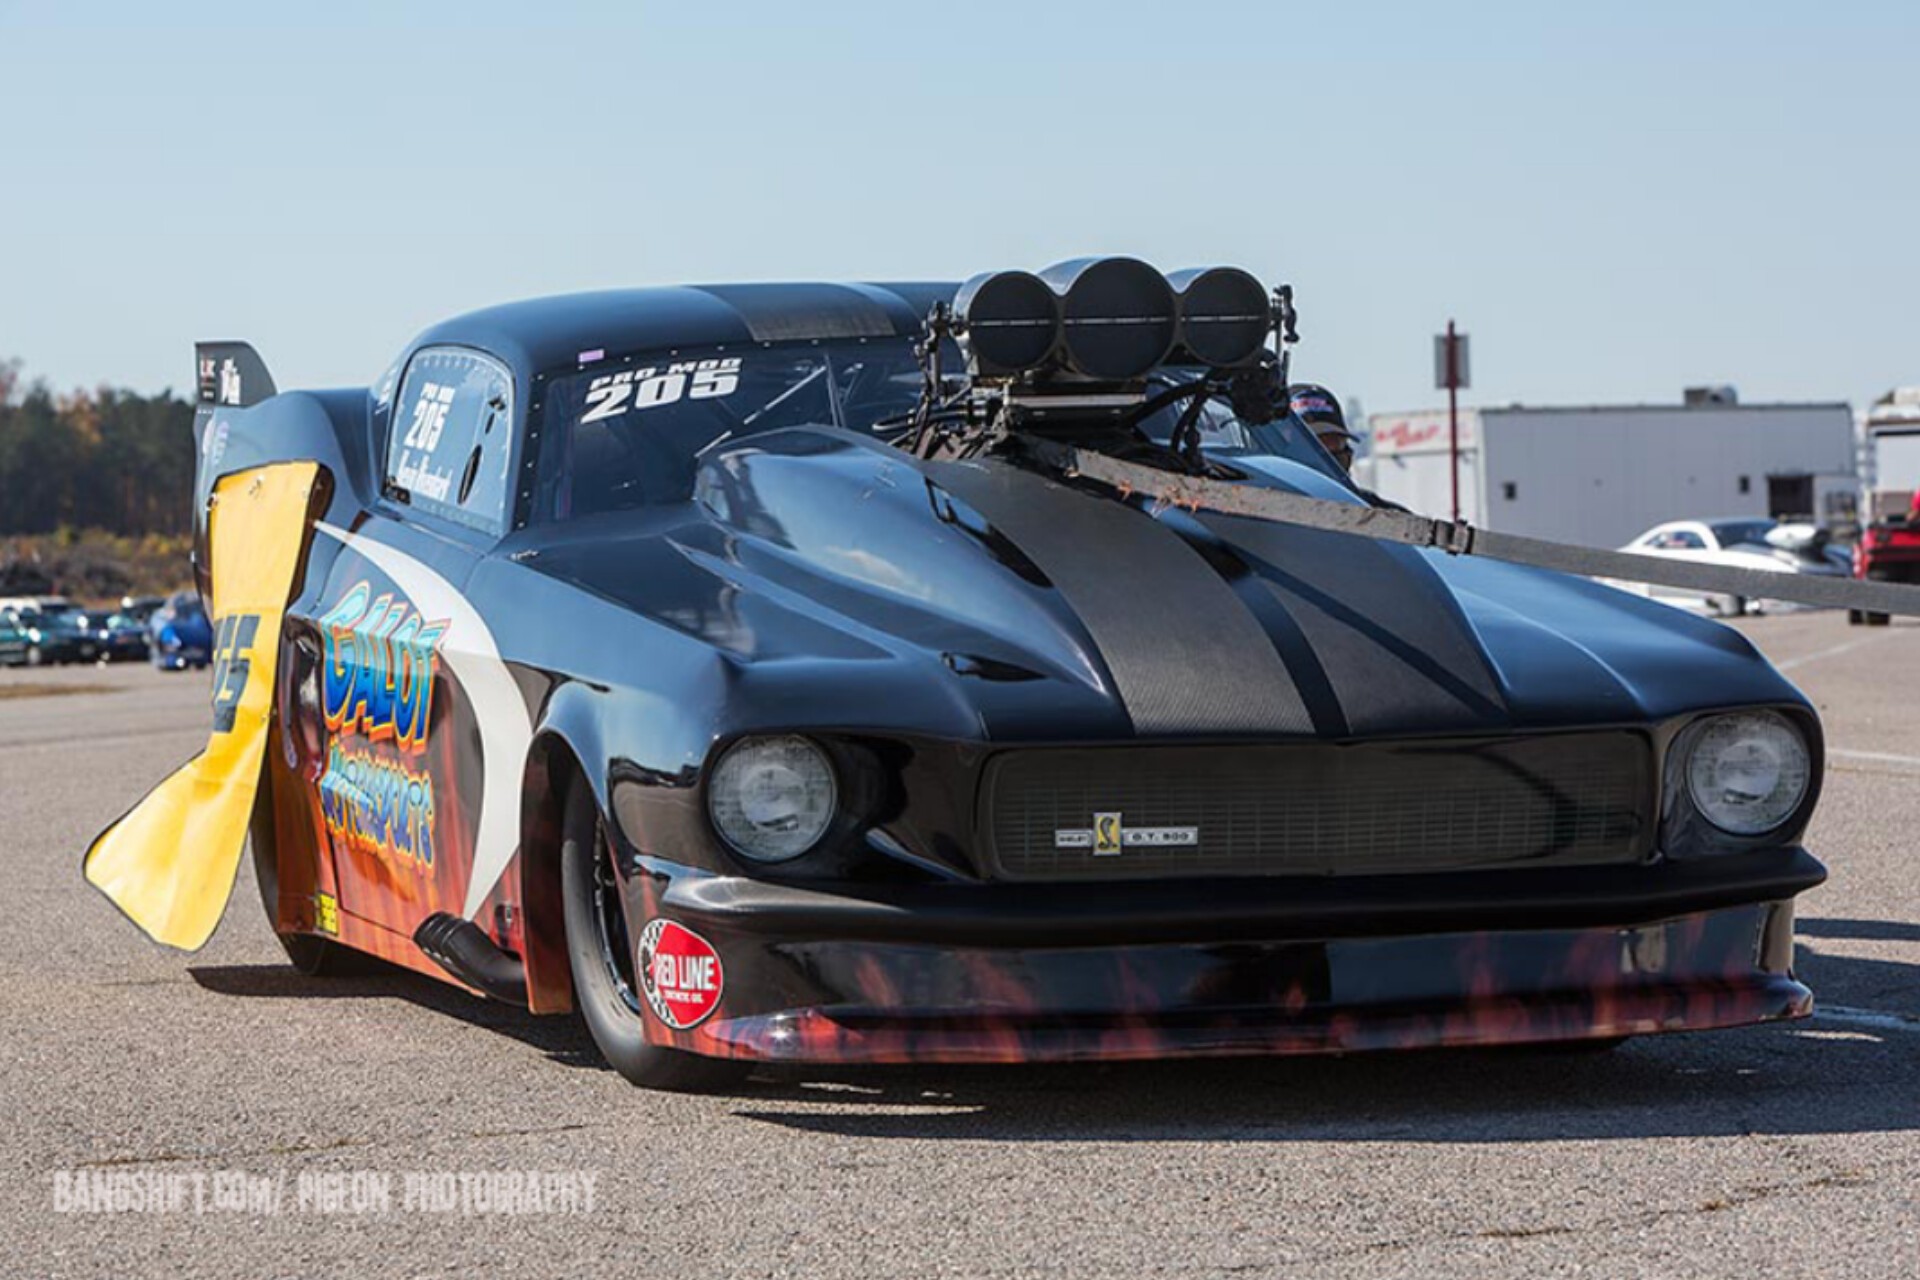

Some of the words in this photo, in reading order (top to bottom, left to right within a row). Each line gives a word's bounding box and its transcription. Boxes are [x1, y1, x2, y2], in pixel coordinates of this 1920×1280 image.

[579, 367, 740, 425] 205
[588, 366, 657, 391] PRO
[667, 357, 743, 376] MOD
[403, 399, 450, 453] 205
[319, 579, 451, 757] GALOT
